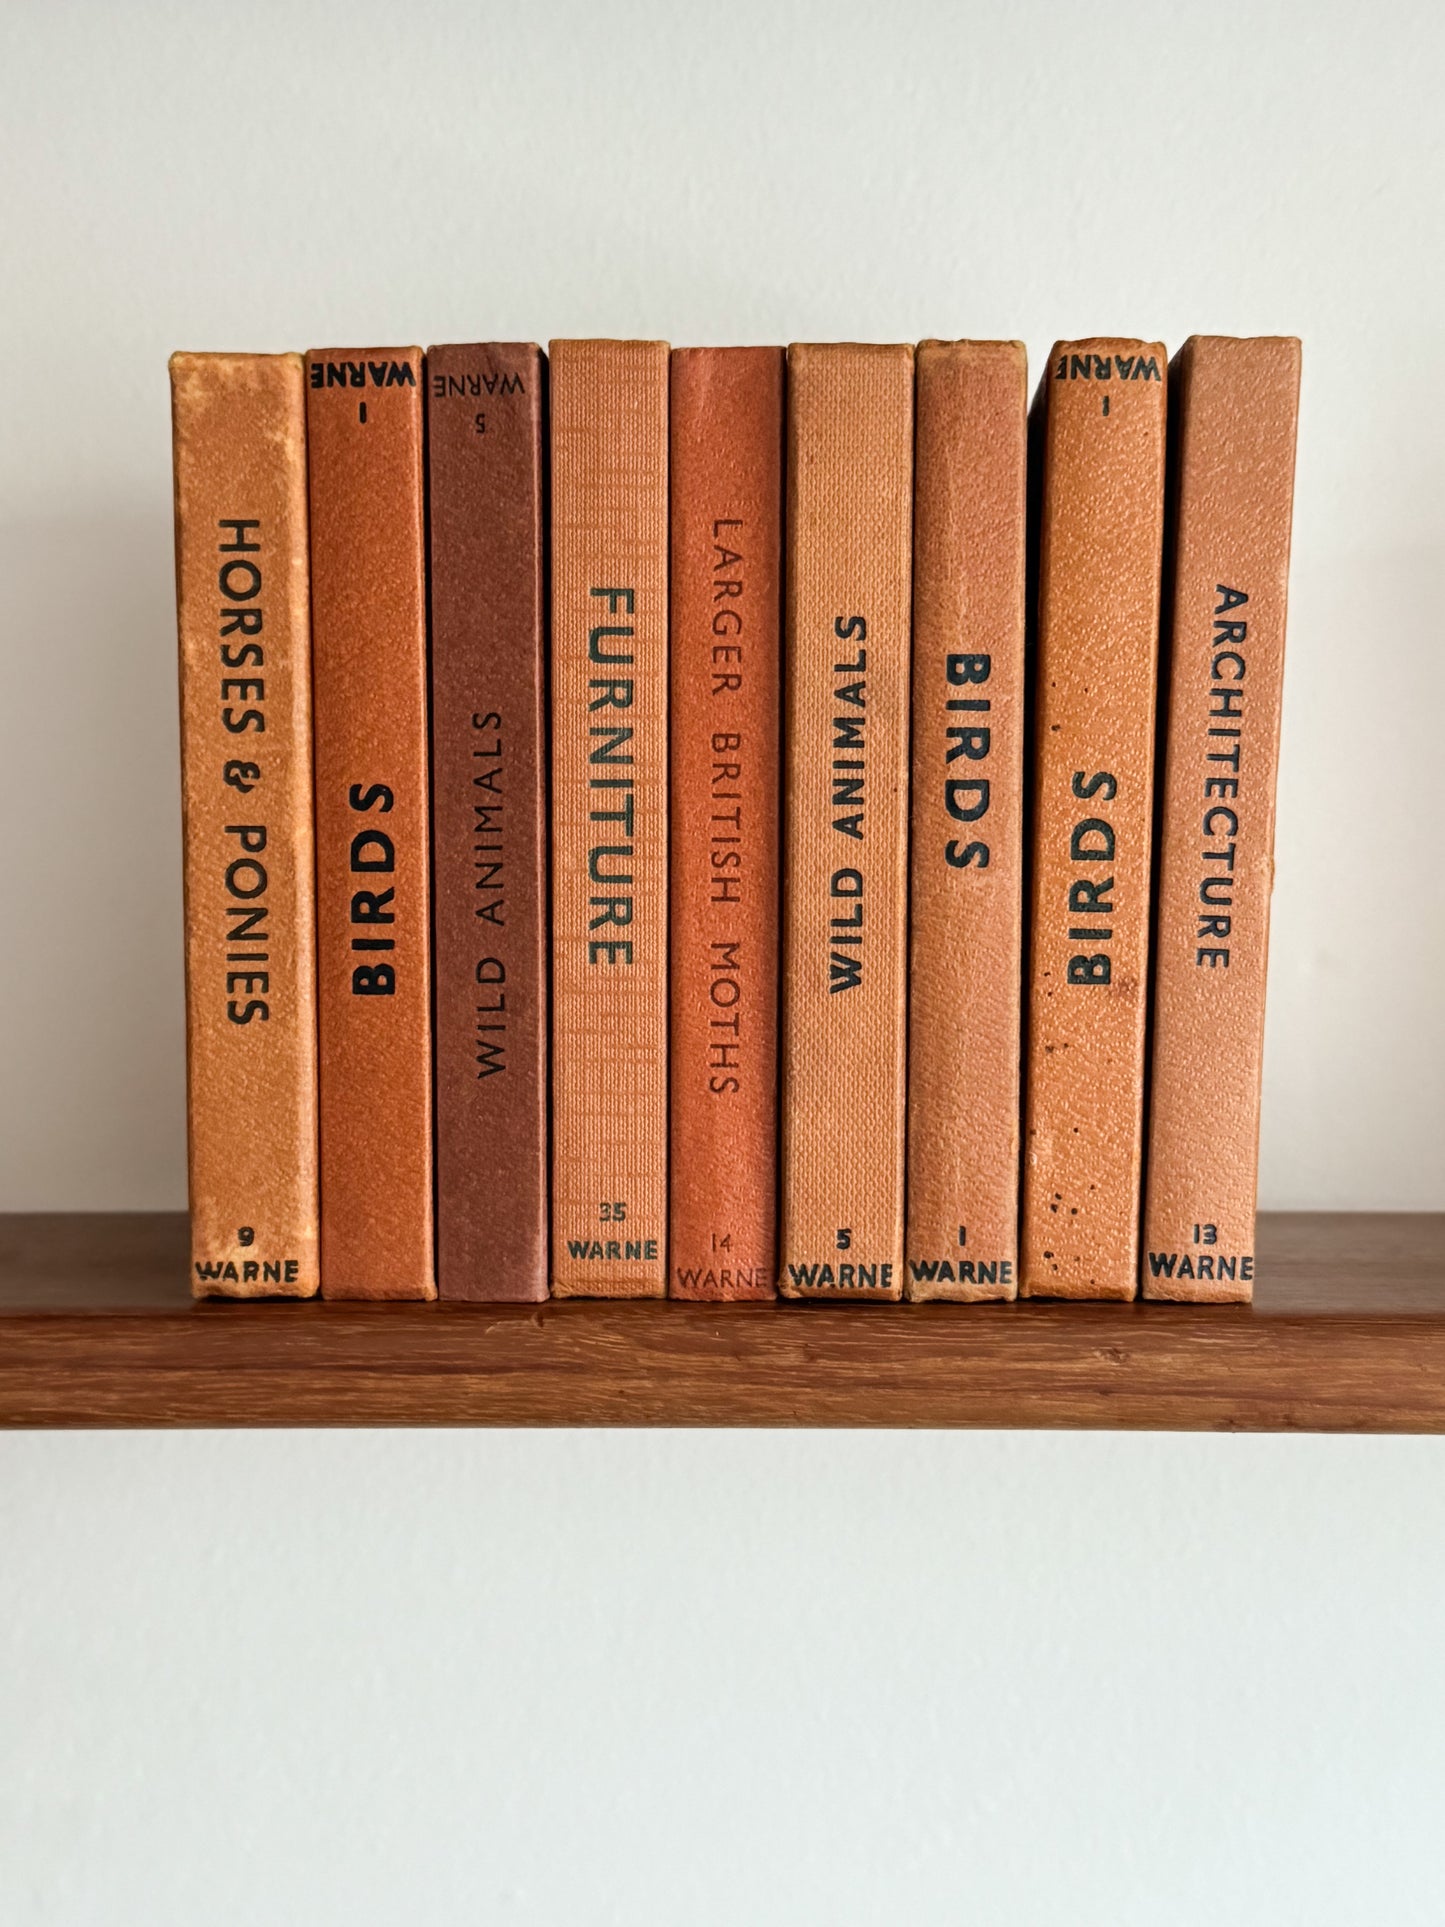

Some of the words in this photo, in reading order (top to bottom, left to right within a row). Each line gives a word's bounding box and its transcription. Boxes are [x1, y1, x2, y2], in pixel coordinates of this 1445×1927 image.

[311, 360, 417, 388] WARNE
[434, 372, 526, 398] WARNE
[359, 402, 367, 424] 1
[1102, 395, 1110, 416] 1
[474, 412, 486, 434] 5
[710, 517, 744, 697] LARGER
[218, 519, 266, 735] HORSES
[830, 614, 868, 842] ANIMALS
[944, 653, 992, 870] BIRDS
[222, 759, 262, 795] &
[587, 586, 635, 967] FURNITURE
[1194, 583, 1249, 970] ARCHITECTURE
[472, 711, 506, 927] ANIMALS
[710, 731, 743, 905] BRITISH
[348, 783, 396, 996] BIRDS
[1066, 770, 1118, 986] BIRDS
[224, 824, 271, 1026] PONIES
[828, 867, 864, 995] WILD
[475, 957, 508, 1080] WILD
[708, 941, 741, 1095] MOTHS
[598, 1202, 627, 1224] 35
[237, 1226, 255, 1248] 9
[711, 1234, 732, 1255] 14
[835, 1228, 852, 1250] 5
[959, 1227, 966, 1246] 1
[1192, 1224, 1218, 1245] 13
[566, 1239, 659, 1262] WARNE
[195, 1259, 300, 1284] WARNE
[676, 1266, 768, 1290] WARNE
[788, 1262, 894, 1289] WARNE
[908, 1259, 1013, 1286] WARNE
[1148, 1251, 1254, 1282] WARNE
